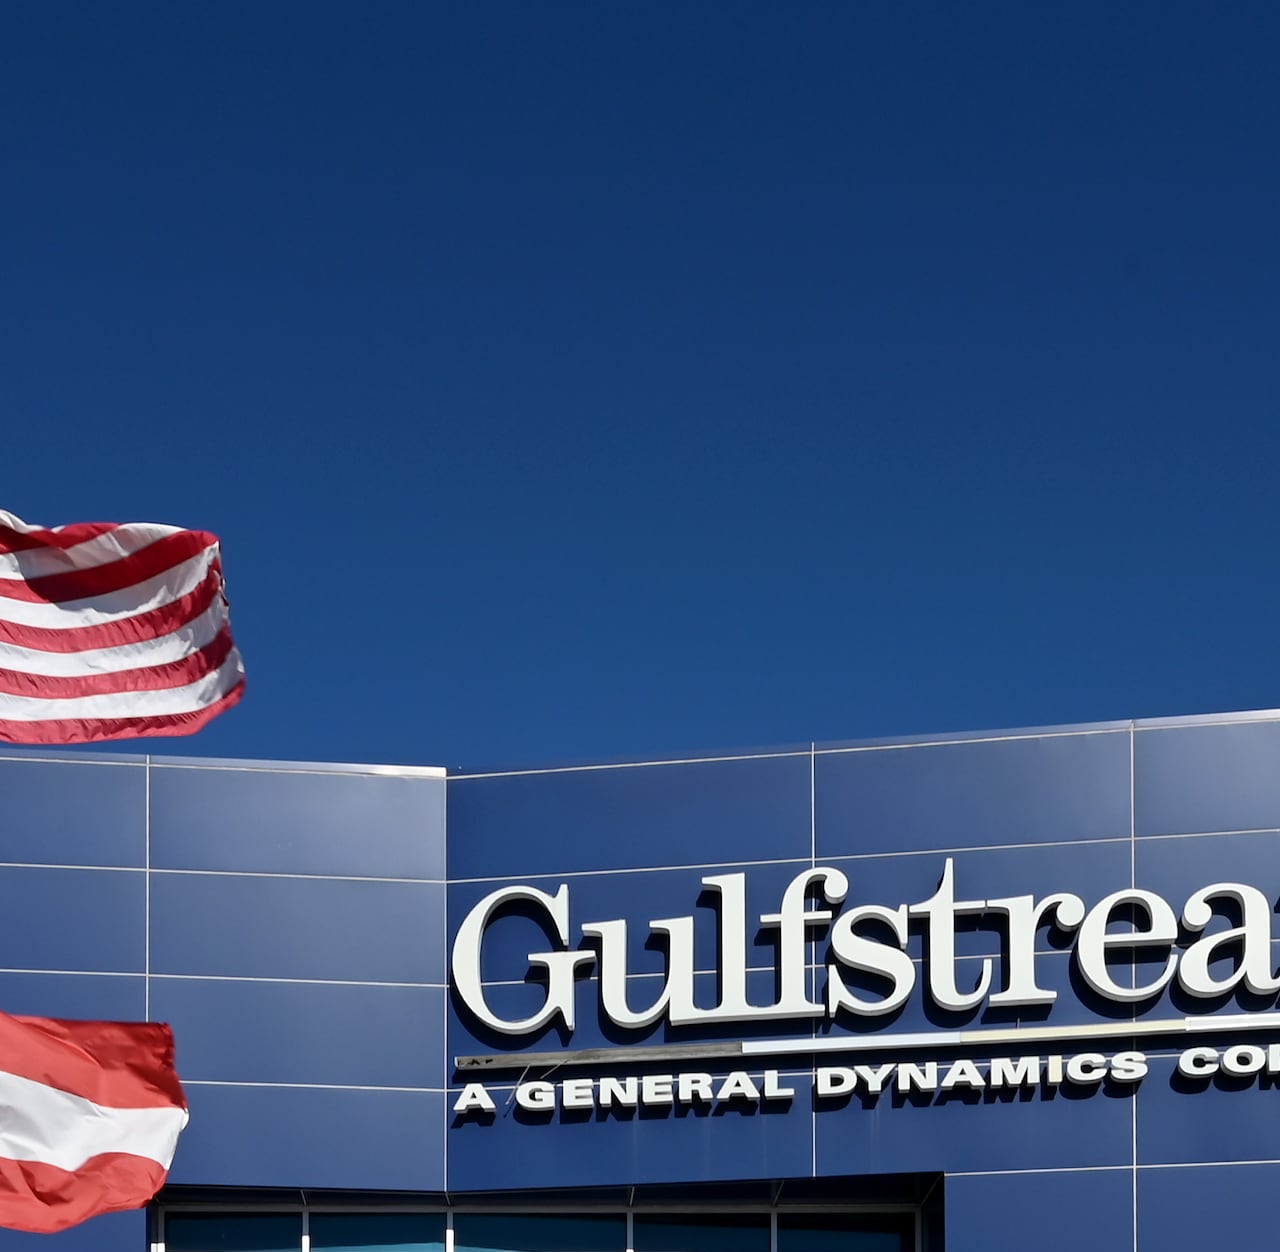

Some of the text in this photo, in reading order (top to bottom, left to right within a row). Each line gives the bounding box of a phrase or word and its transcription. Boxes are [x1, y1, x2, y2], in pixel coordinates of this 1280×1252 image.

[453, 1083, 496, 1113] A
[515, 1070, 794, 1112] GENERAL
[817, 1050, 1148, 1096] DYNAMICS
